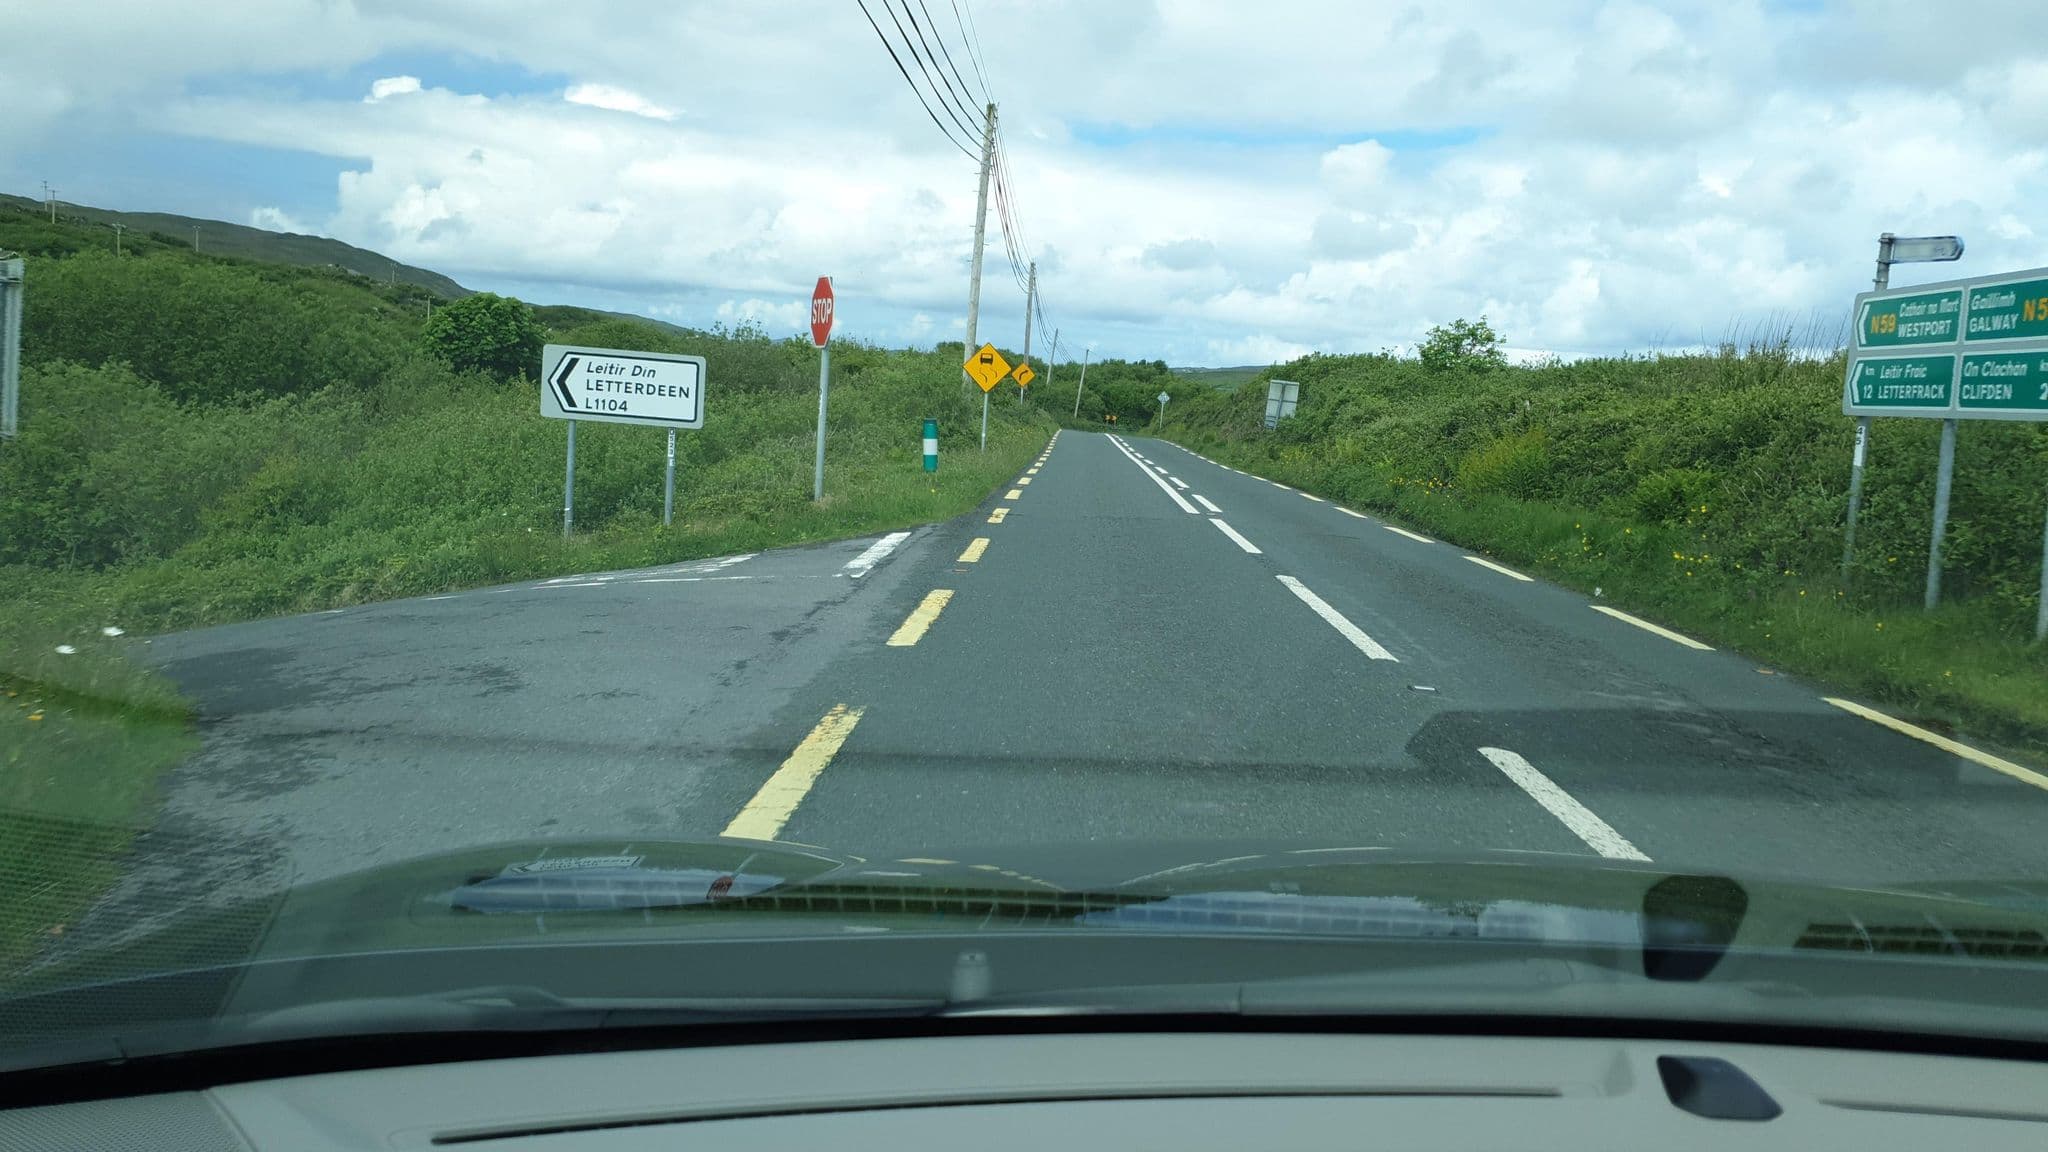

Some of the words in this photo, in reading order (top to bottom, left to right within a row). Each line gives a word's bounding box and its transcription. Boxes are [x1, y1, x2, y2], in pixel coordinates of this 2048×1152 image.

[1939, 298, 1959, 313] Mart
[1971, 291, 2016, 310] Gaillimh
[812, 298, 832, 324] STOP
[1871, 314, 1896, 334] N59
[1898, 320, 1952, 337] WESTPORT
[1970, 313, 2019, 332] GALWAY
[587, 361, 626, 378] Leitir
[1865, 366, 1875, 376] km
[1880, 365, 1903, 379] Leitir
[586, 379, 690, 398] LETTERDEEN
[1863, 384, 1873, 399] 12
[1878, 384, 1945, 399] LETTERFRACK
[1962, 384, 2013, 400] CLIFDEN
[585, 397, 628, 412] L1104
